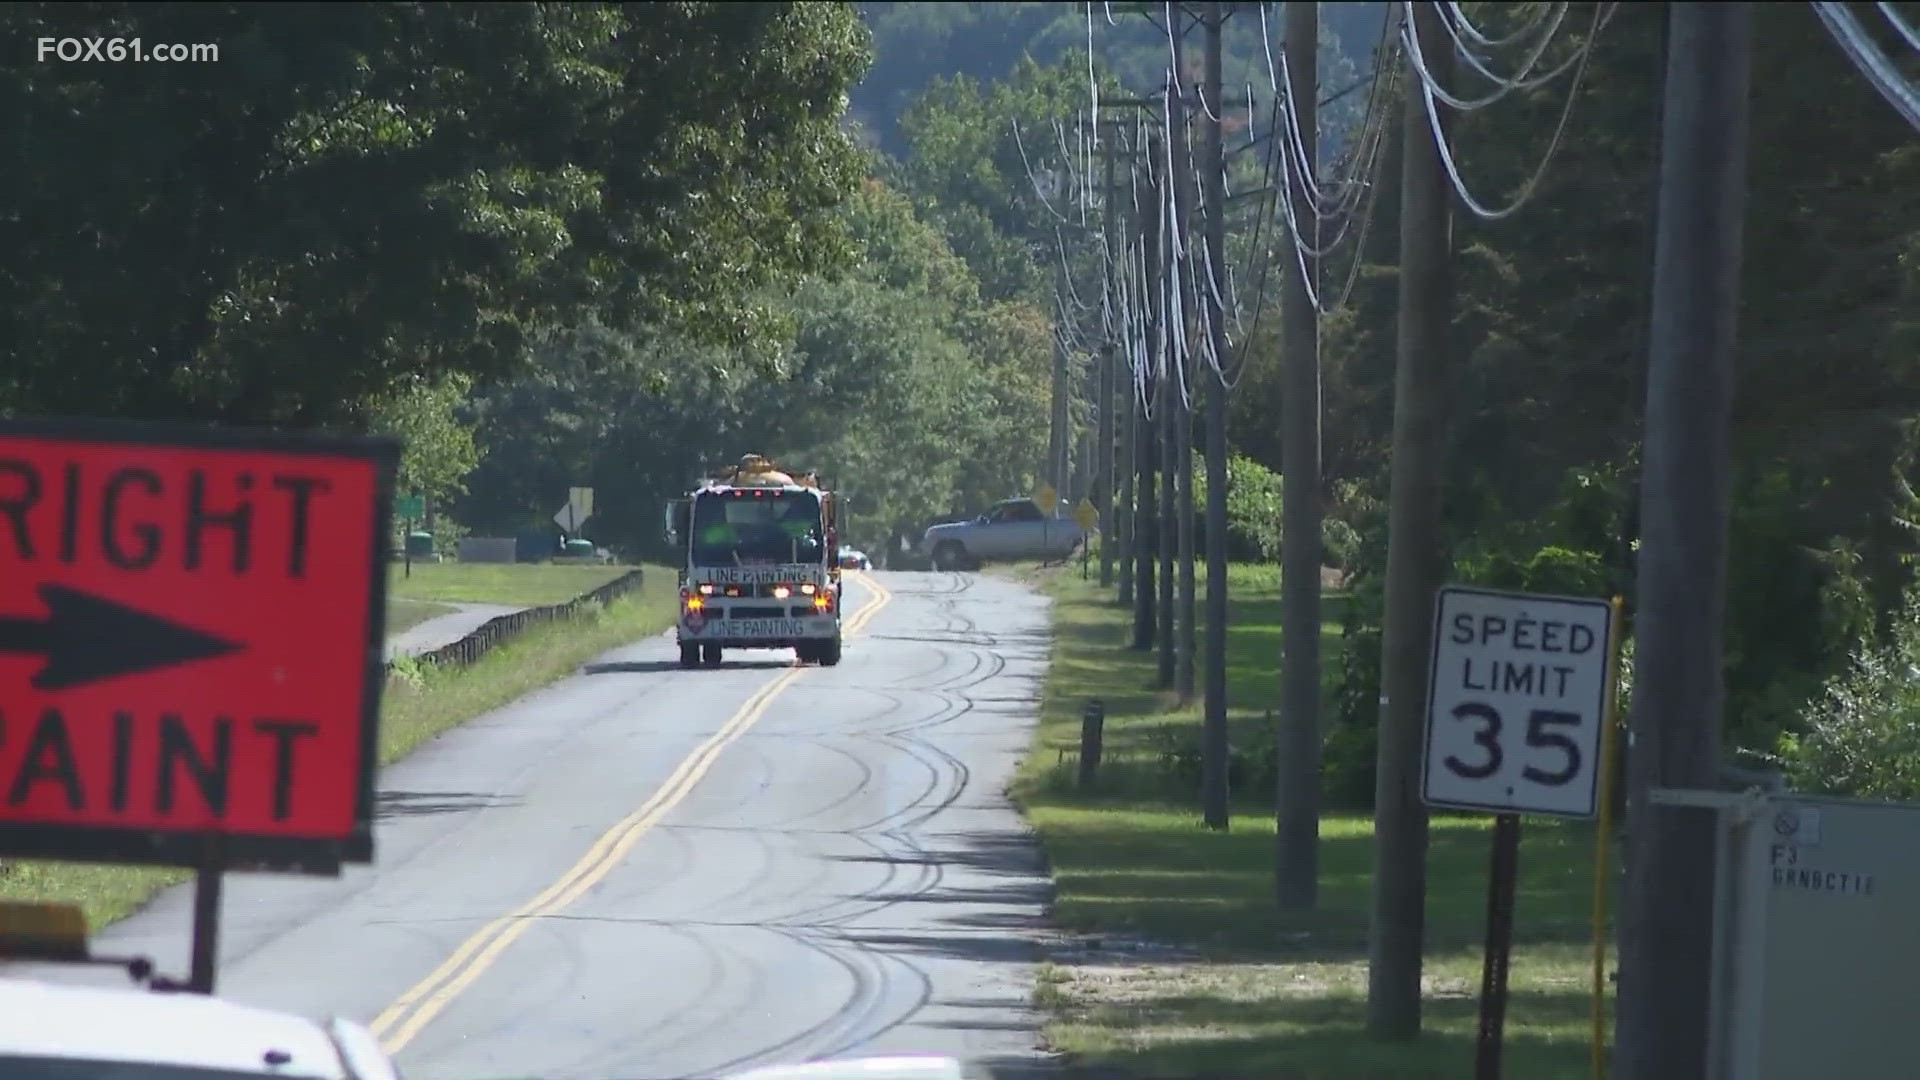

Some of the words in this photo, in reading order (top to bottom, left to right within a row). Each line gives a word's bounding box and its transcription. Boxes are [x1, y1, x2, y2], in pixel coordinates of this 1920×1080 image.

[0, 459, 332, 578] RIGHT
[707, 569, 738, 582] LINE
[743, 568, 807, 582] PAINTING
[710, 621, 739, 635] LINE
[743, 620, 804, 635] PAINTING
[1452, 613, 1595, 654] SPEED
[1462, 657, 1575, 698] LIMIT
[0, 707, 319, 822] AINT
[1444, 702, 1582, 787] 35
